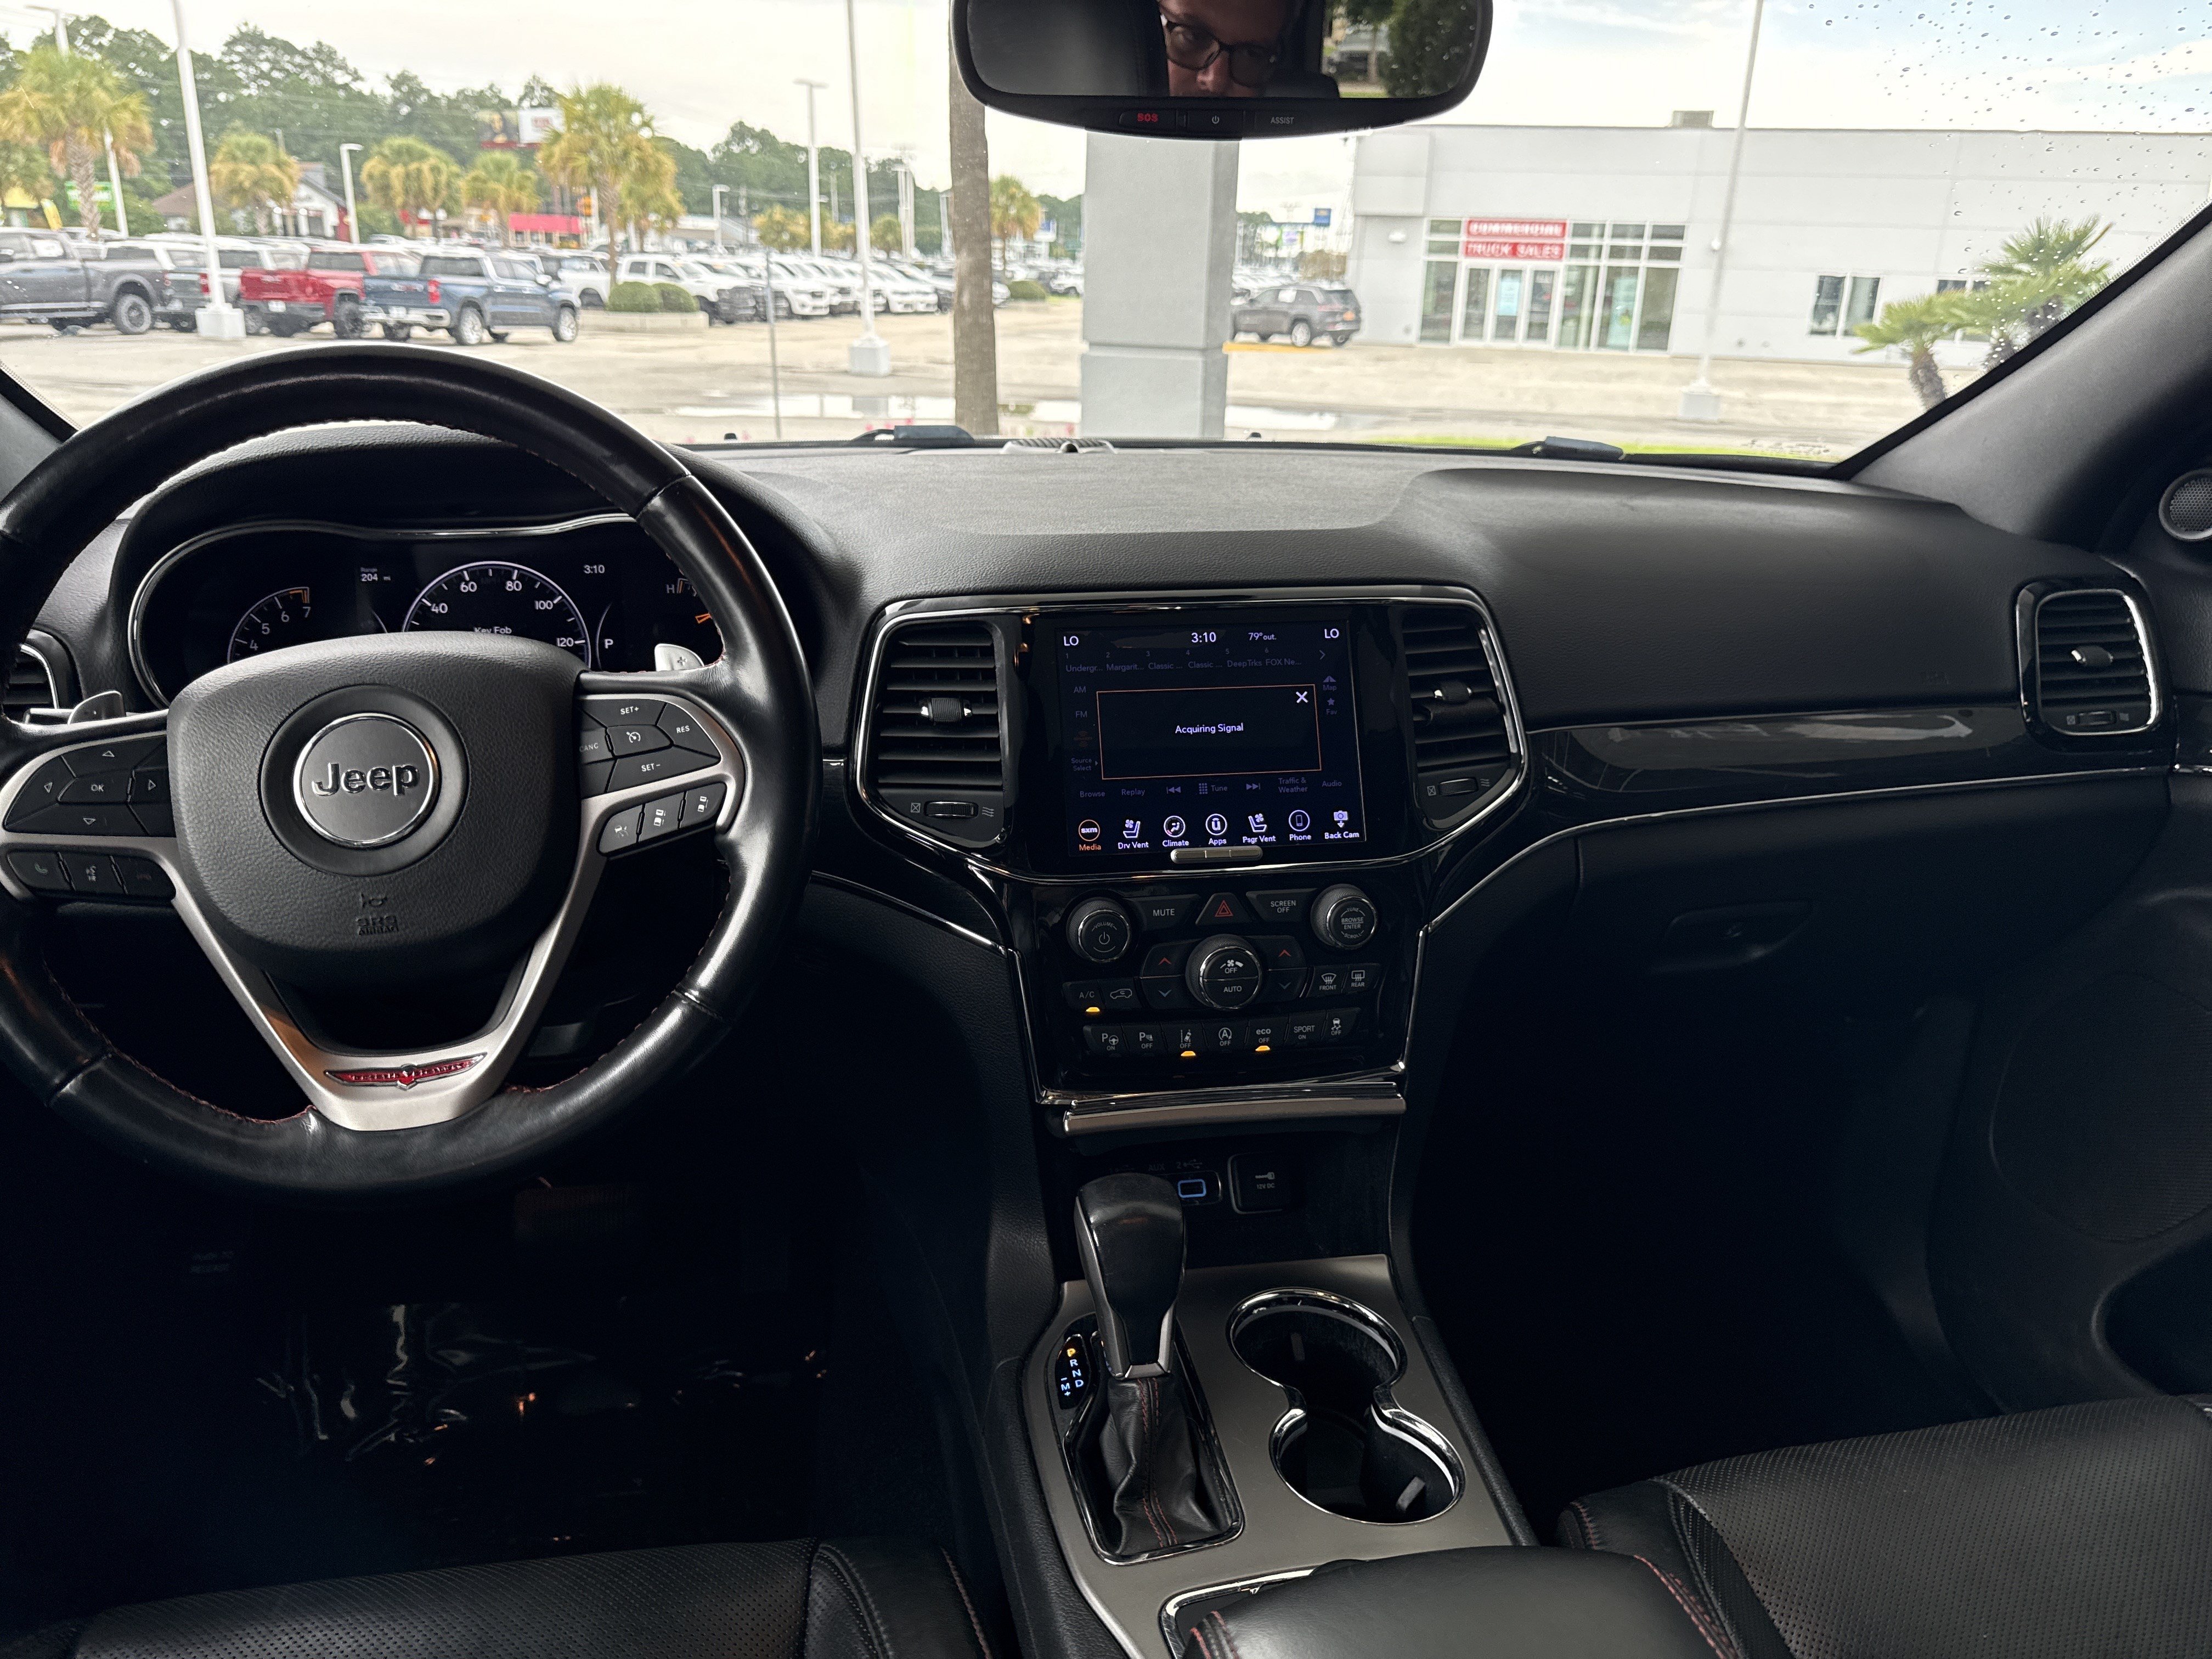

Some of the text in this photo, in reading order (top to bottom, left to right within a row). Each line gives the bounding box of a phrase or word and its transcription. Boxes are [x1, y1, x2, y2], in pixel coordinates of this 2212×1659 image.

[1137, 113, 1159, 122] SOS
[1270, 116, 1294, 125] ASSIST
[1516, 244, 1561, 258] SALES
[583, 565, 605, 574] 3:10
[361, 573, 378, 582] 204
[460, 581, 477, 592] 60
[505, 580, 522, 591] 80
[667, 584, 675, 594] H
[431, 603, 448, 614] 40
[534, 600, 554, 610] 100
[280, 611, 290, 623] 6
[302, 607, 311, 618] 7
[261, 623, 270, 635] 5
[1324, 628, 1339, 638] LO
[556, 637, 574, 647] 120
[1063, 635, 1079, 646] LO
[1191, 631, 1216, 643] 3:10
[250, 640, 258, 651] 4
[605, 639, 613, 648] P
[676, 725, 690, 733] RES
[1175, 723, 1244, 734] Acquiring Signal
[311, 763, 420, 797] Jeep
[91, 784, 104, 793] OK
[1121, 788, 1146, 797] Replay
[1079, 991, 1095, 999] A/C
[1293, 1025, 1316, 1034] SPORT
[1066, 1348, 1076, 1357] P
[1070, 1359, 1079, 1368] R
[1072, 1368, 1081, 1378] N
[1060, 1383, 1070, 1391] M
[1075, 1379, 1084, 1388] D
